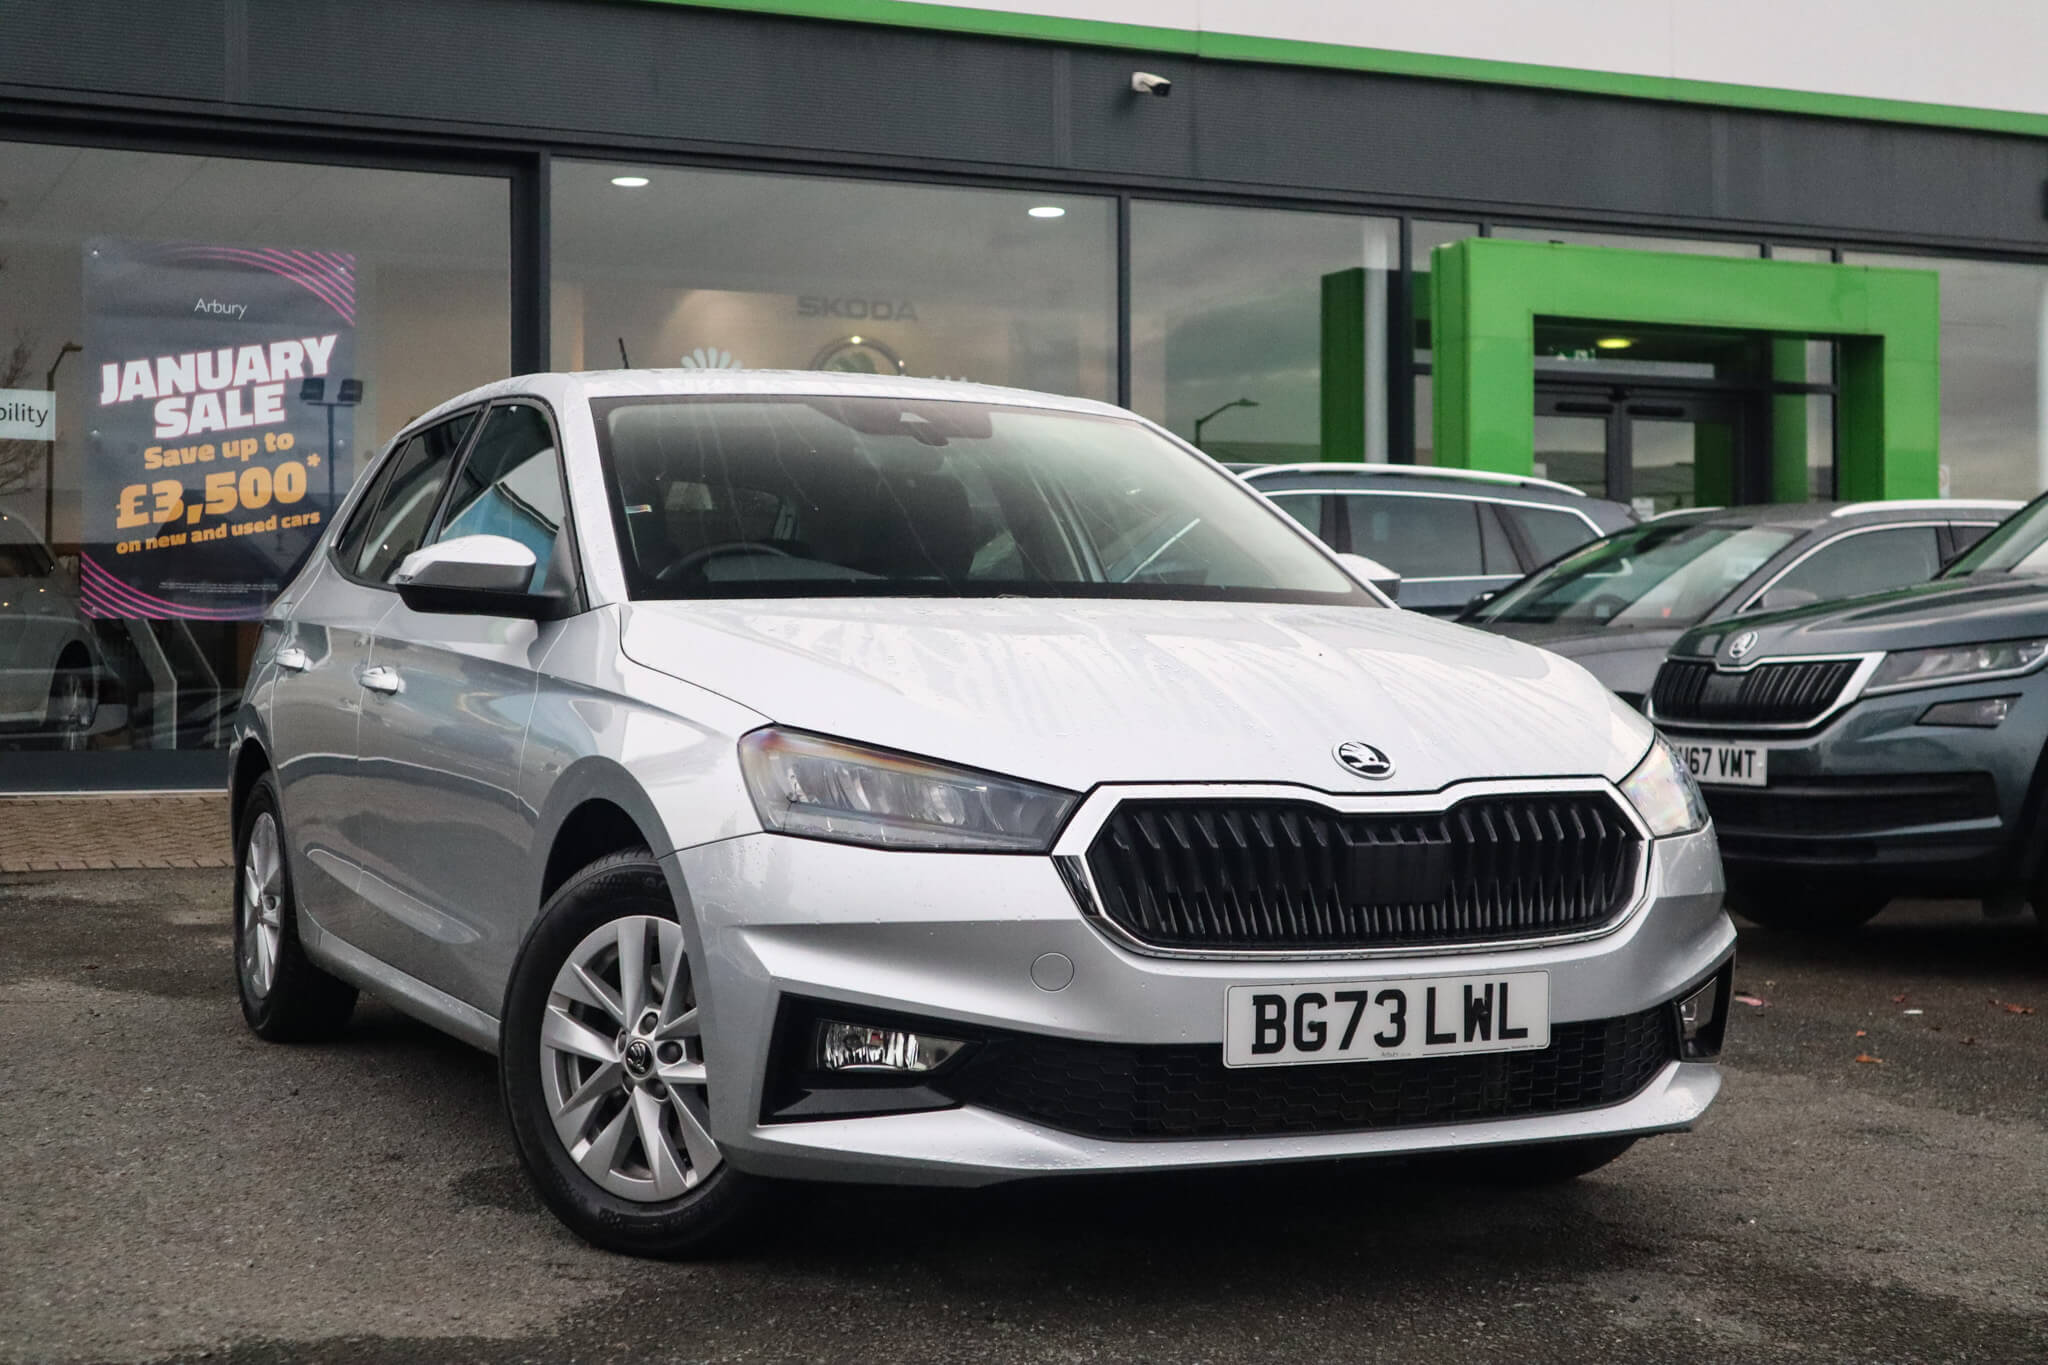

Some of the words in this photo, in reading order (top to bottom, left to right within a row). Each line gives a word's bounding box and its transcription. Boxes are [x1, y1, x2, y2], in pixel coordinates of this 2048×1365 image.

[194, 299, 247, 320] Arbury
[100, 334, 337, 405] JANUARY
[153, 382, 286, 439] SALE
[144, 443, 216, 470] Save
[222, 438, 259, 461] up
[264, 432, 294, 452] to
[116, 539, 141, 555] on
[145, 532, 187, 551] new
[191, 523, 227, 543] and
[231, 514, 278, 536] used
[281, 511, 321, 529] cars
[1718, 748, 1757, 779] VMT
[1251, 989, 1407, 1055] BG73
[1425, 982, 1528, 1045] LWL
